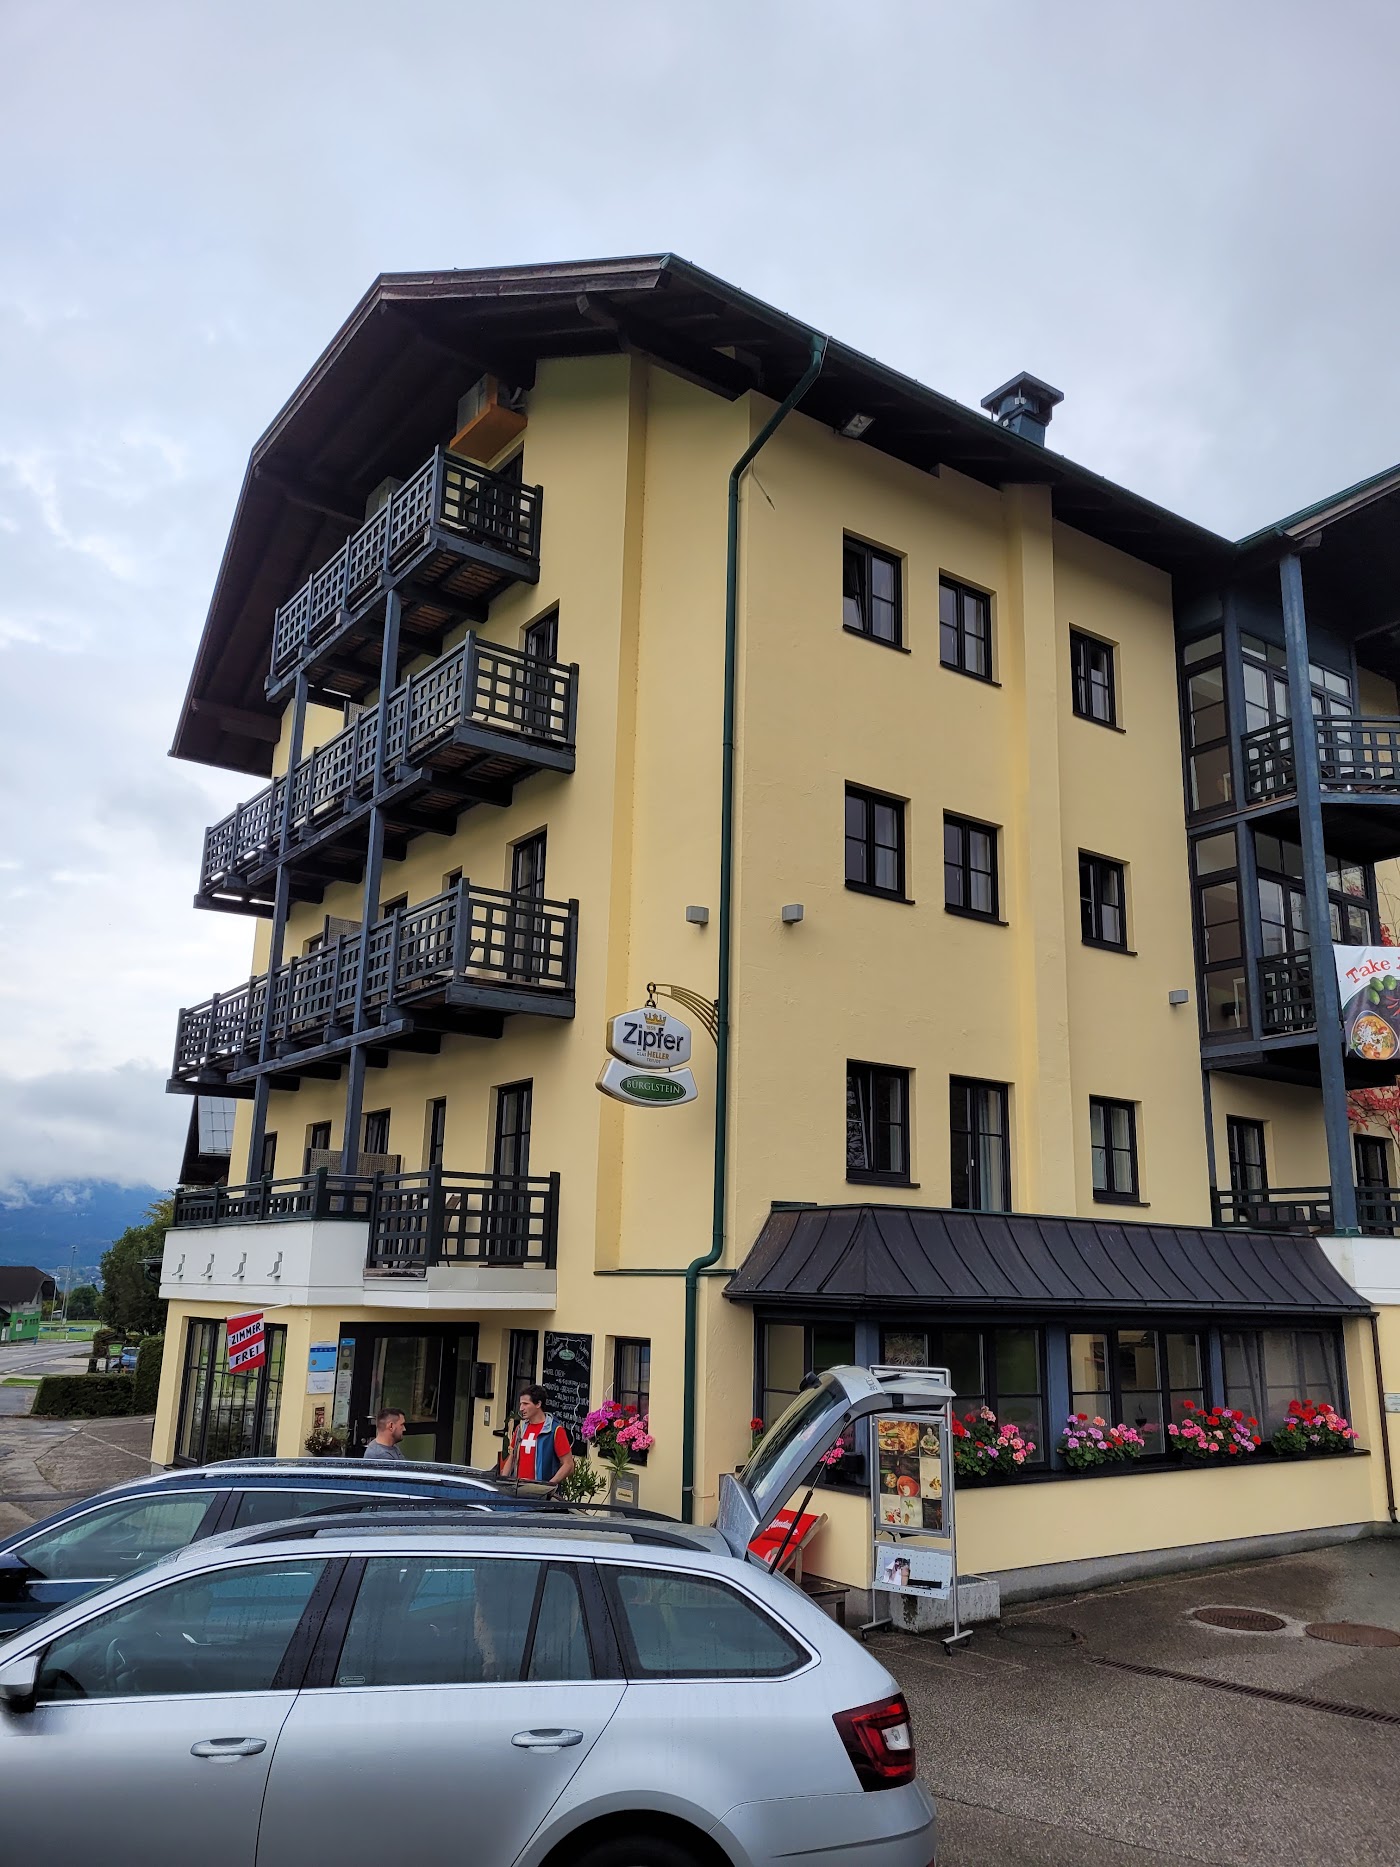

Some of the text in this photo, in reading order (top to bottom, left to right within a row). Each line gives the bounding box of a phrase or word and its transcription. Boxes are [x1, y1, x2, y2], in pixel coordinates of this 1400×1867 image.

[1345, 958, 1391, 984] Take
[622, 1021, 684, 1052] Zipfer
[647, 1050, 670, 1060] HELLER
[626, 1080, 681, 1094] BÜRGLSTEIN
[231, 1322, 261, 1345] ZIMMER
[235, 1345, 259, 1365] FREI
